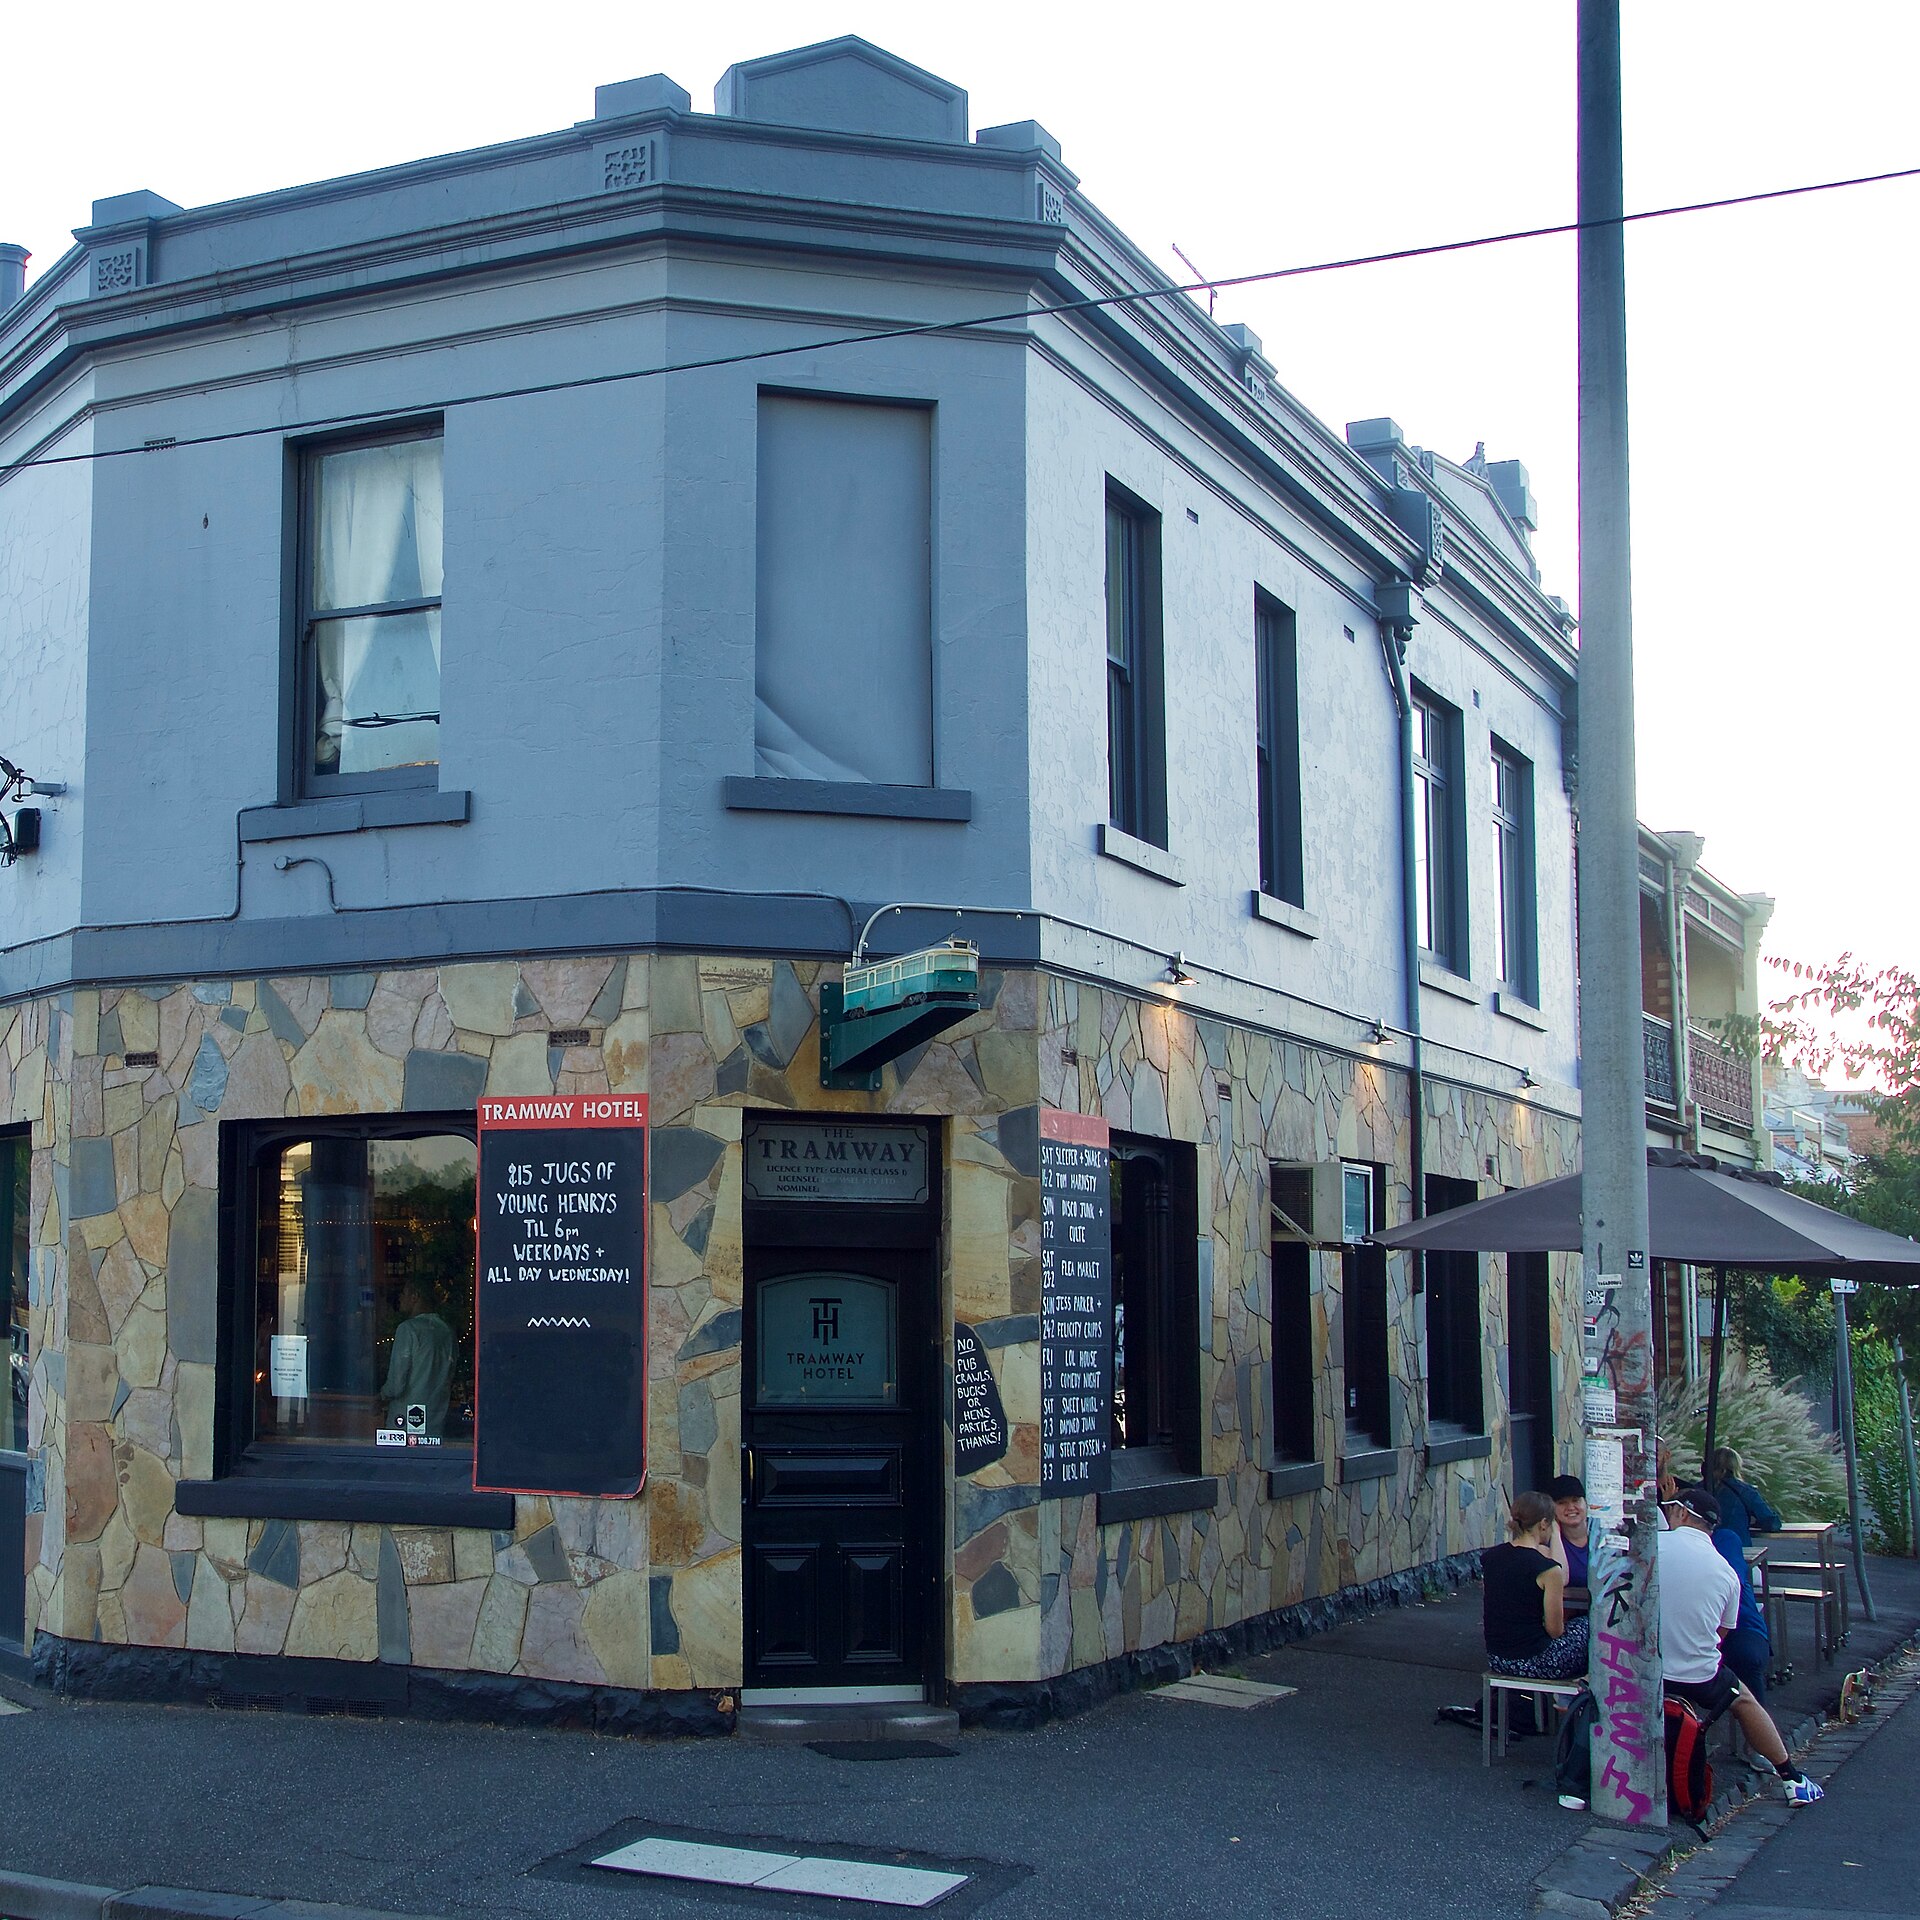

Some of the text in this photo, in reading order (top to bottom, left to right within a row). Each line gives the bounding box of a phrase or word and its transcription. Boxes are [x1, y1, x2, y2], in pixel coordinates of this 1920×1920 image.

[482, 1101, 642, 1120] TRAMWAY HOTEL
[821, 1127, 854, 1138] THE
[758, 1138, 915, 1163] TRAMWAY
[1041, 1145, 1054, 1165] SAT
[1055, 1146, 1078, 1166] SLEEPER
[507, 1162, 616, 1187] $15 JUGS OF
[766, 1165, 800, 1173] LICENCE
[829, 1166, 867, 1175] GENERAL
[1055, 1172, 1068, 1189] TOM
[497, 1193, 617, 1215] YOUNG HENRYS
[1042, 1196, 1055, 1216] SUN
[1061, 1199, 1078, 1217] DISCO
[524, 1219, 548, 1238] TIL
[513, 1244, 590, 1262] WEEKDAYS
[1042, 1249, 1100, 1279] SAT FLEA MARKET
[487, 1266, 630, 1284] ALL DAY WEDNESDAY!
[1042, 1296, 1055, 1316] SUN
[1055, 1295, 1072, 1311] JESS
[1073, 1295, 1095, 1313] PARKER
[1057, 1321, 1082, 1339] FELICITY
[957, 1338, 974, 1351] NO
[787, 1352, 865, 1365] TRAMWAY
[957, 1357, 977, 1372] PUB
[1042, 1347, 1053, 1366] FRI
[1079, 1350, 1098, 1368] HOUSE
[803, 1368, 854, 1379] HOTEL
[1060, 1372, 1081, 1389] COMEDY
[1083, 1370, 1102, 1389] NIGHT
[957, 1384, 987, 1399] BUCKS
[967, 1397, 981, 1408] OR
[1043, 1397, 1054, 1416] SAT
[1061, 1396, 1080, 1415] SWEET
[963, 1406, 991, 1421] HENS
[957, 1432, 1001, 1452] THANKS!
[1043, 1442, 1055, 1460] SUN
[1059, 1441, 1076, 1459] STEVE
